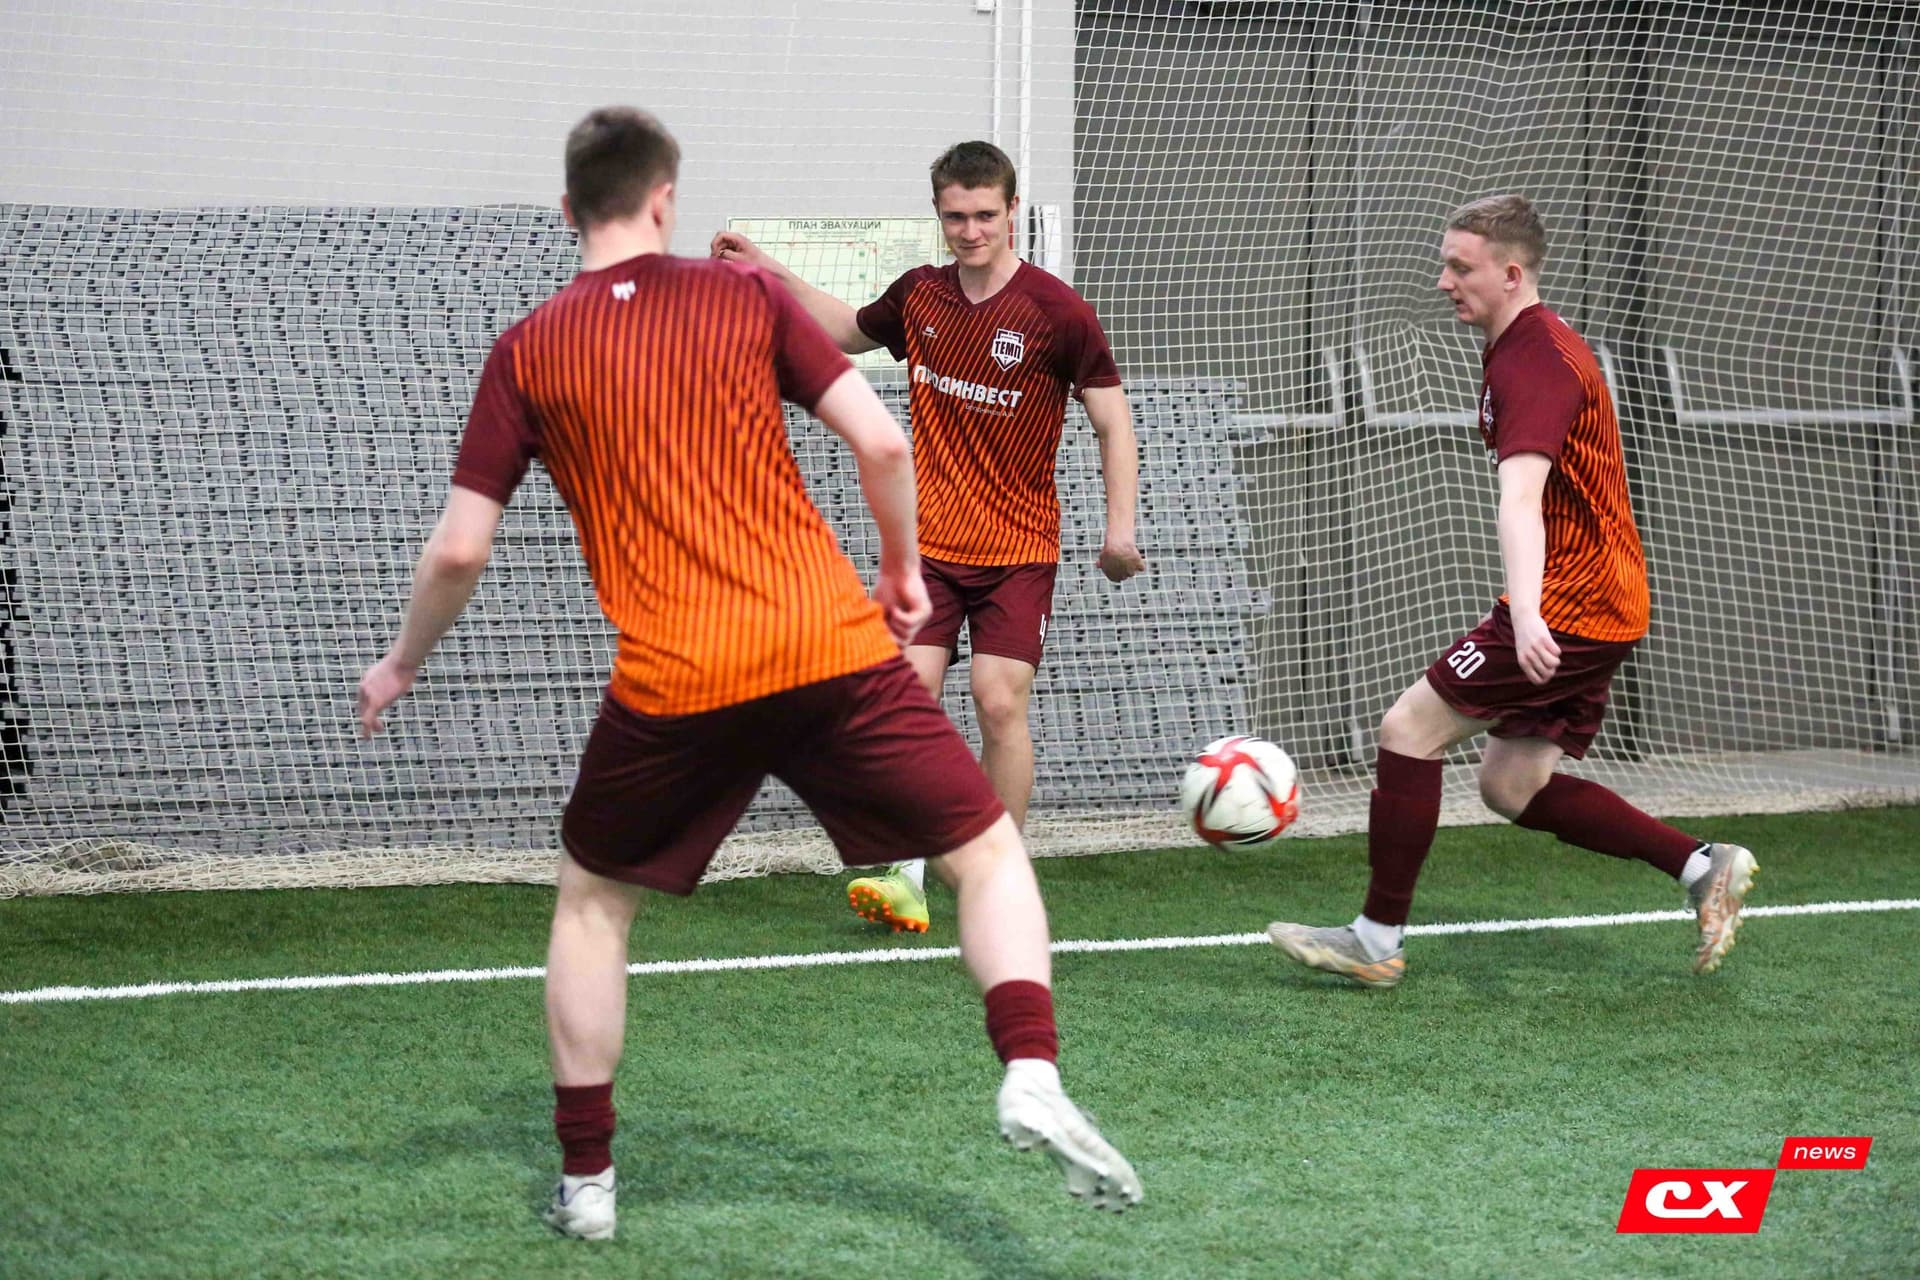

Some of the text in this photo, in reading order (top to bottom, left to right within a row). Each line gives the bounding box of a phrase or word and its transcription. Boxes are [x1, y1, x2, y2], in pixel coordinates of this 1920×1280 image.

[788, 220, 882, 231] ПЛАН ЭВАКУАЦИИ
[995, 340, 1022, 360] ТЕМП
[1446, 640, 1486, 680] 20
